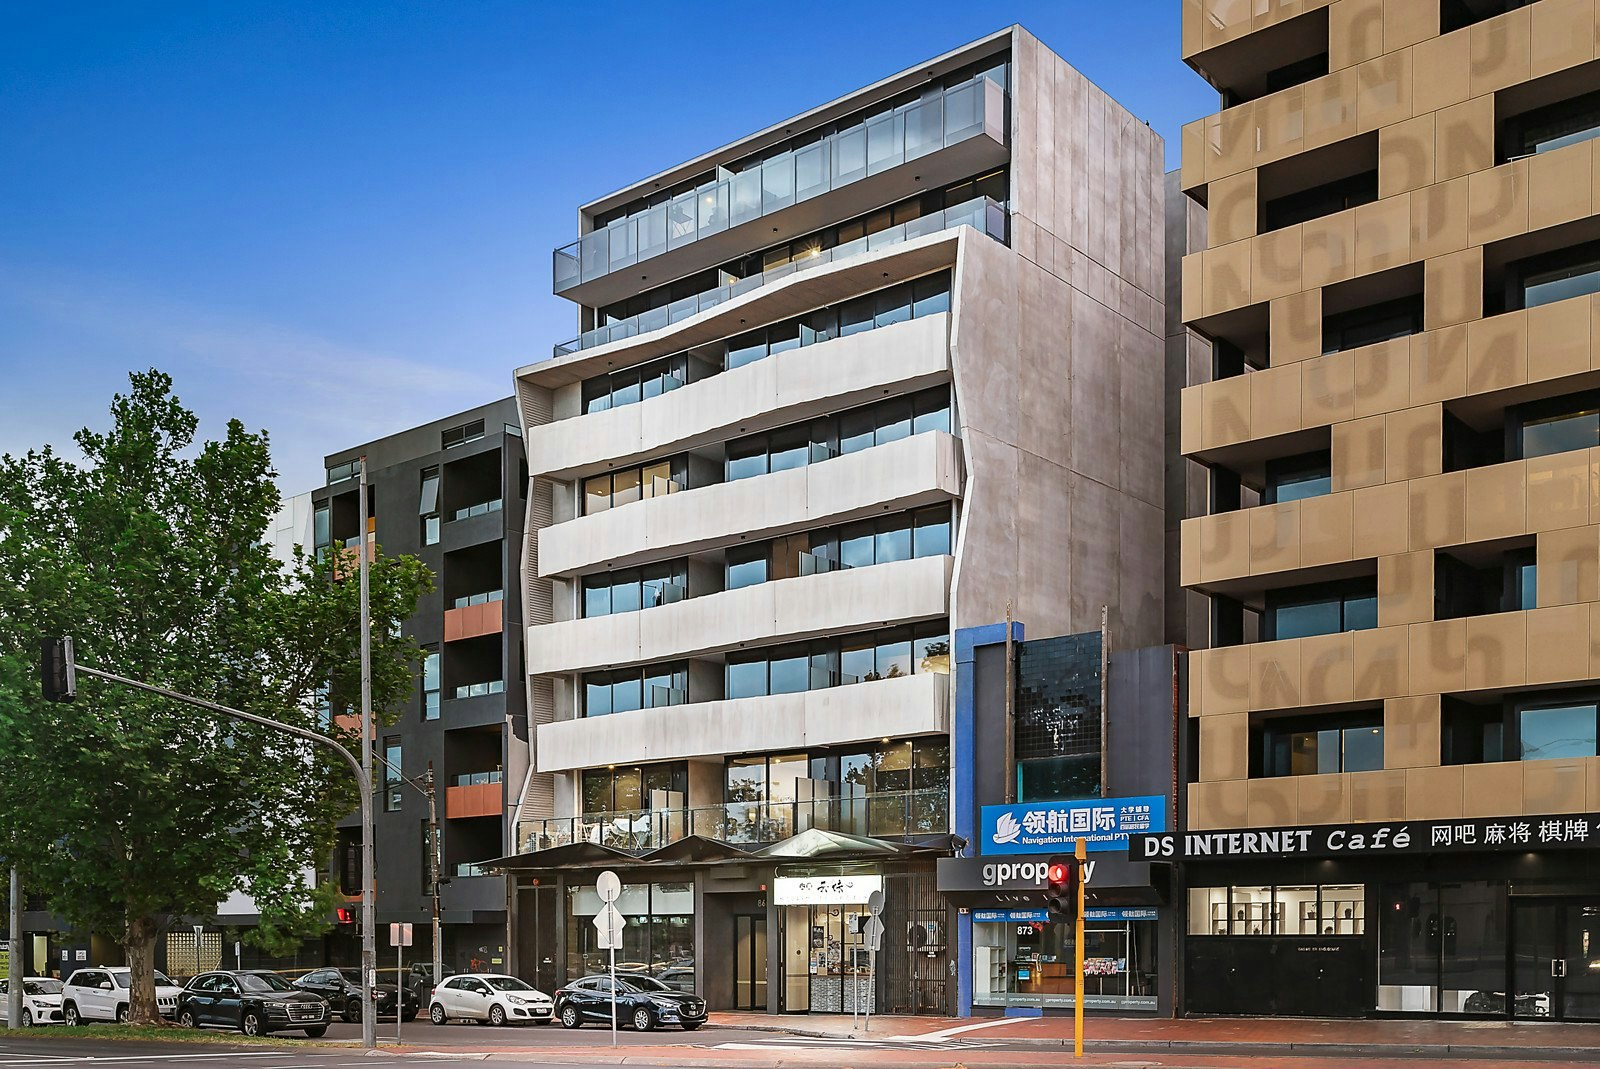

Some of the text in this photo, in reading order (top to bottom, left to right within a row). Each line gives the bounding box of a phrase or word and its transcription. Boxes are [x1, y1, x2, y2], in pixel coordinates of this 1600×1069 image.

[1022, 807, 1115, 834] 领航国际
[1431, 818, 1589, 847] 网吧 麻将 棋牌
[1022, 836, 1062, 846] Navigation
[1063, 833, 1111, 844] Inteational
[1144, 826, 1411, 857] DS INTERNET Café
[1017, 926, 1033, 935] 873
